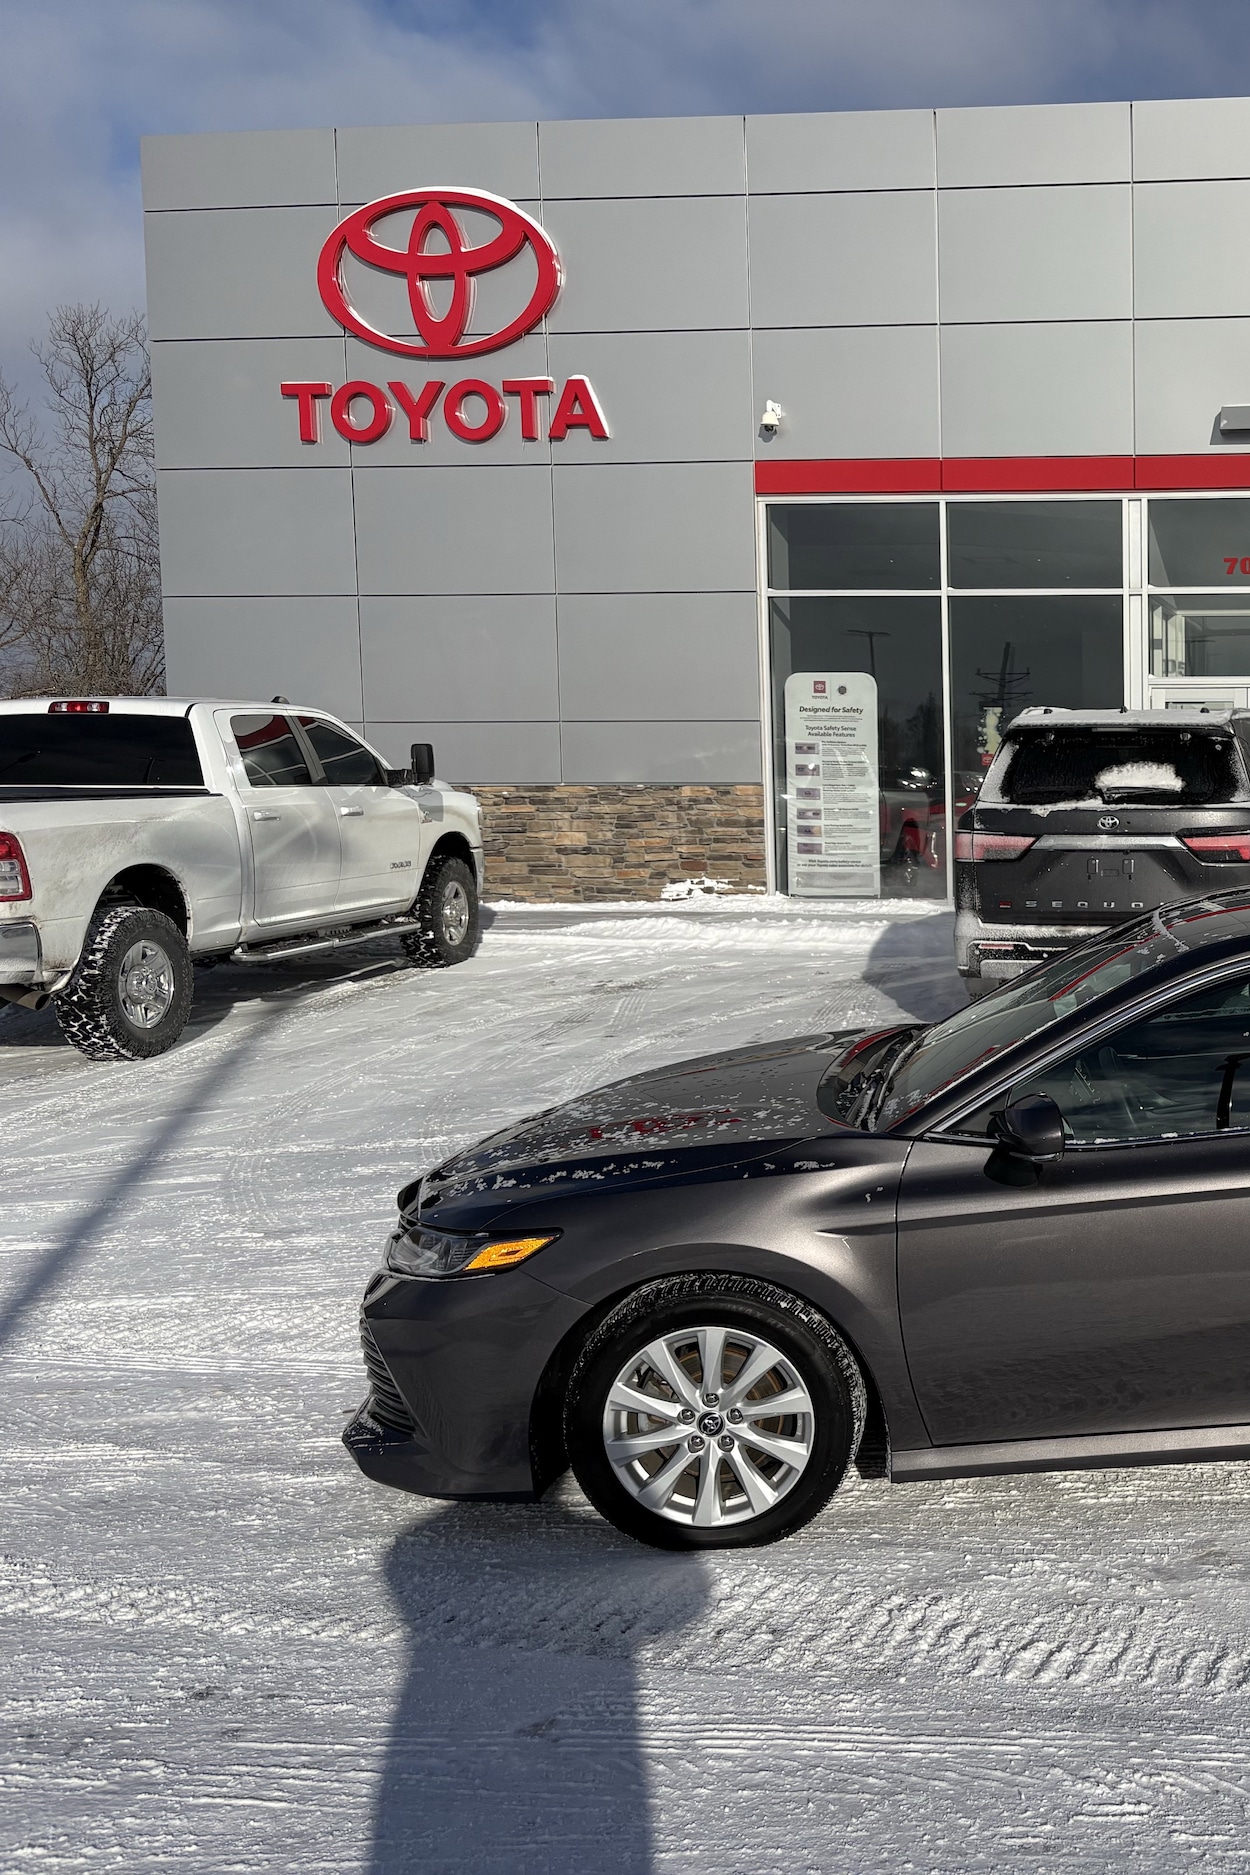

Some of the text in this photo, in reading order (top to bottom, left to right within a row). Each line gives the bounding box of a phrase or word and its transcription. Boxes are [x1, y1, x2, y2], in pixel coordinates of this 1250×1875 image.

[281, 375, 611, 444] TOYOTA
[799, 706, 831, 714] Designed
[842, 706, 864, 715] Safety
